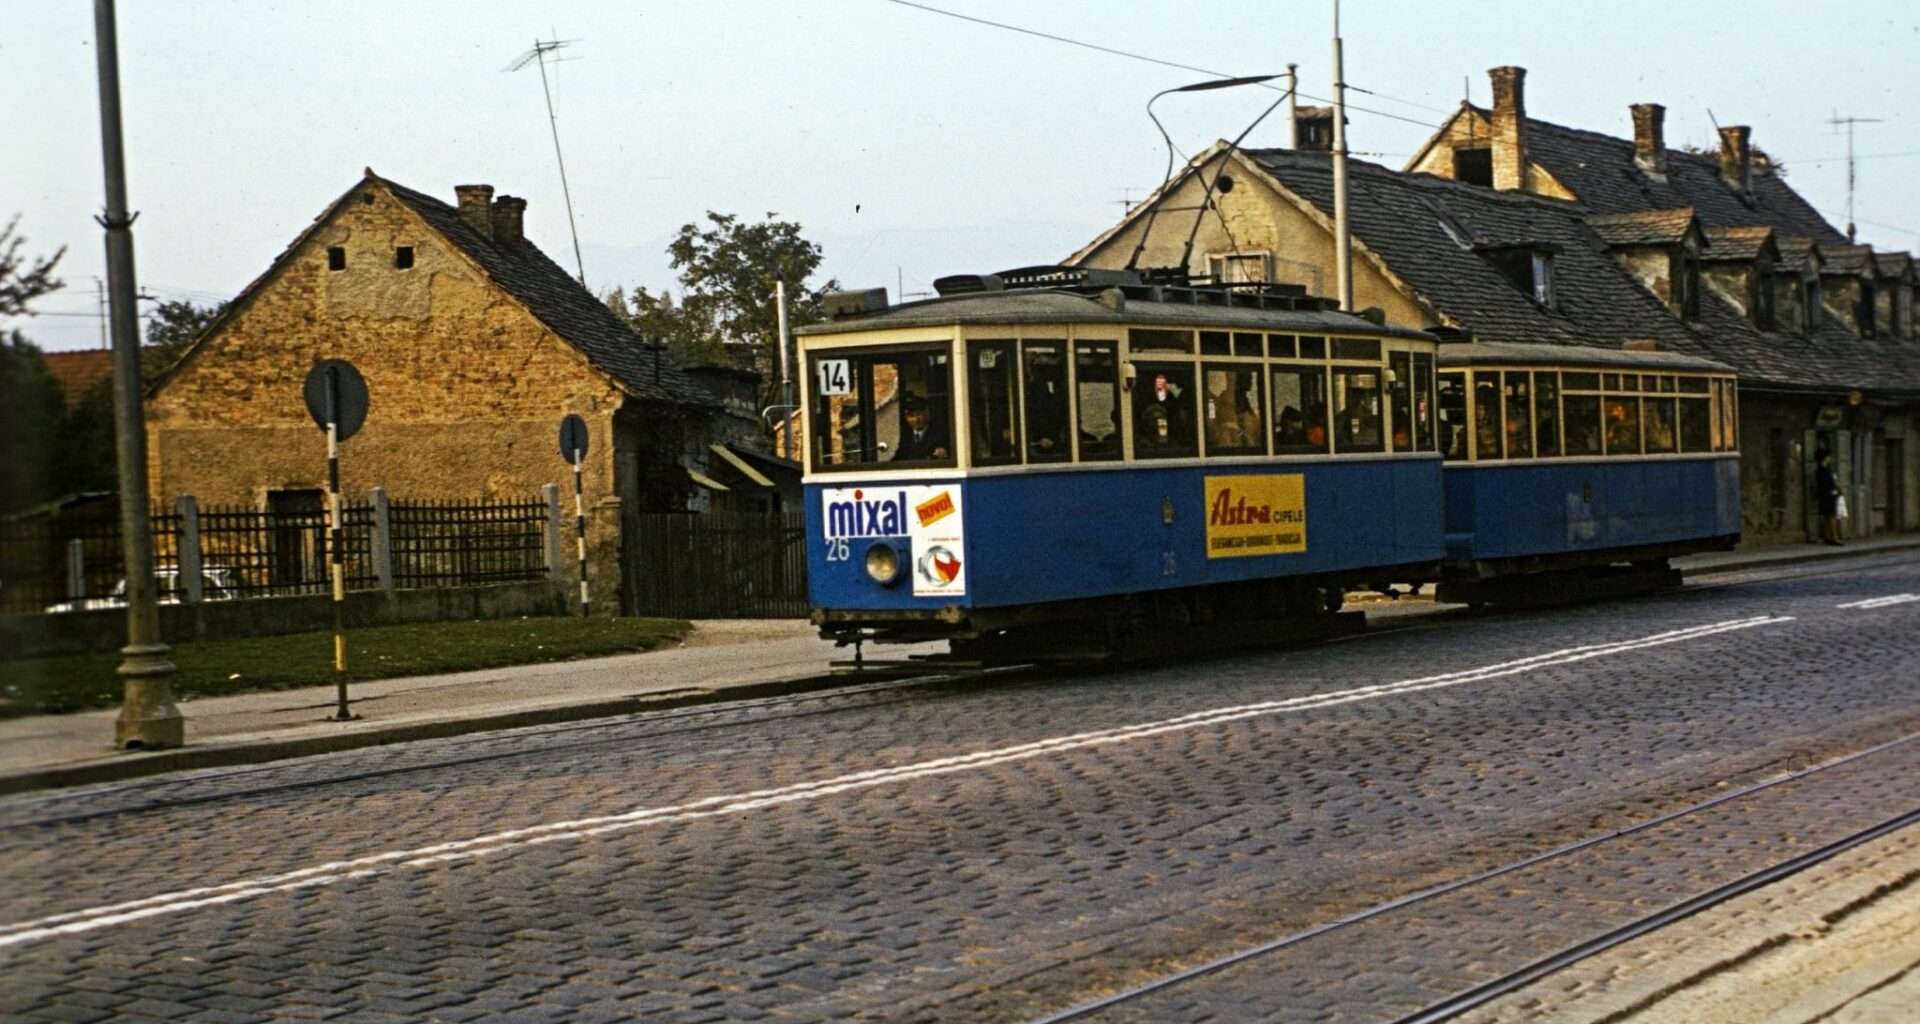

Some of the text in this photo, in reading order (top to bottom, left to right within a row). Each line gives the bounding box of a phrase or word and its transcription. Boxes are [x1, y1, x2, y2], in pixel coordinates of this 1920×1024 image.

[822, 362, 846, 392] 14
[829, 489, 908, 537] mixal
[1210, 487, 1303, 526] Astra CIPELE
[825, 537, 850, 561] 26
[1163, 551, 1177, 576] 26
